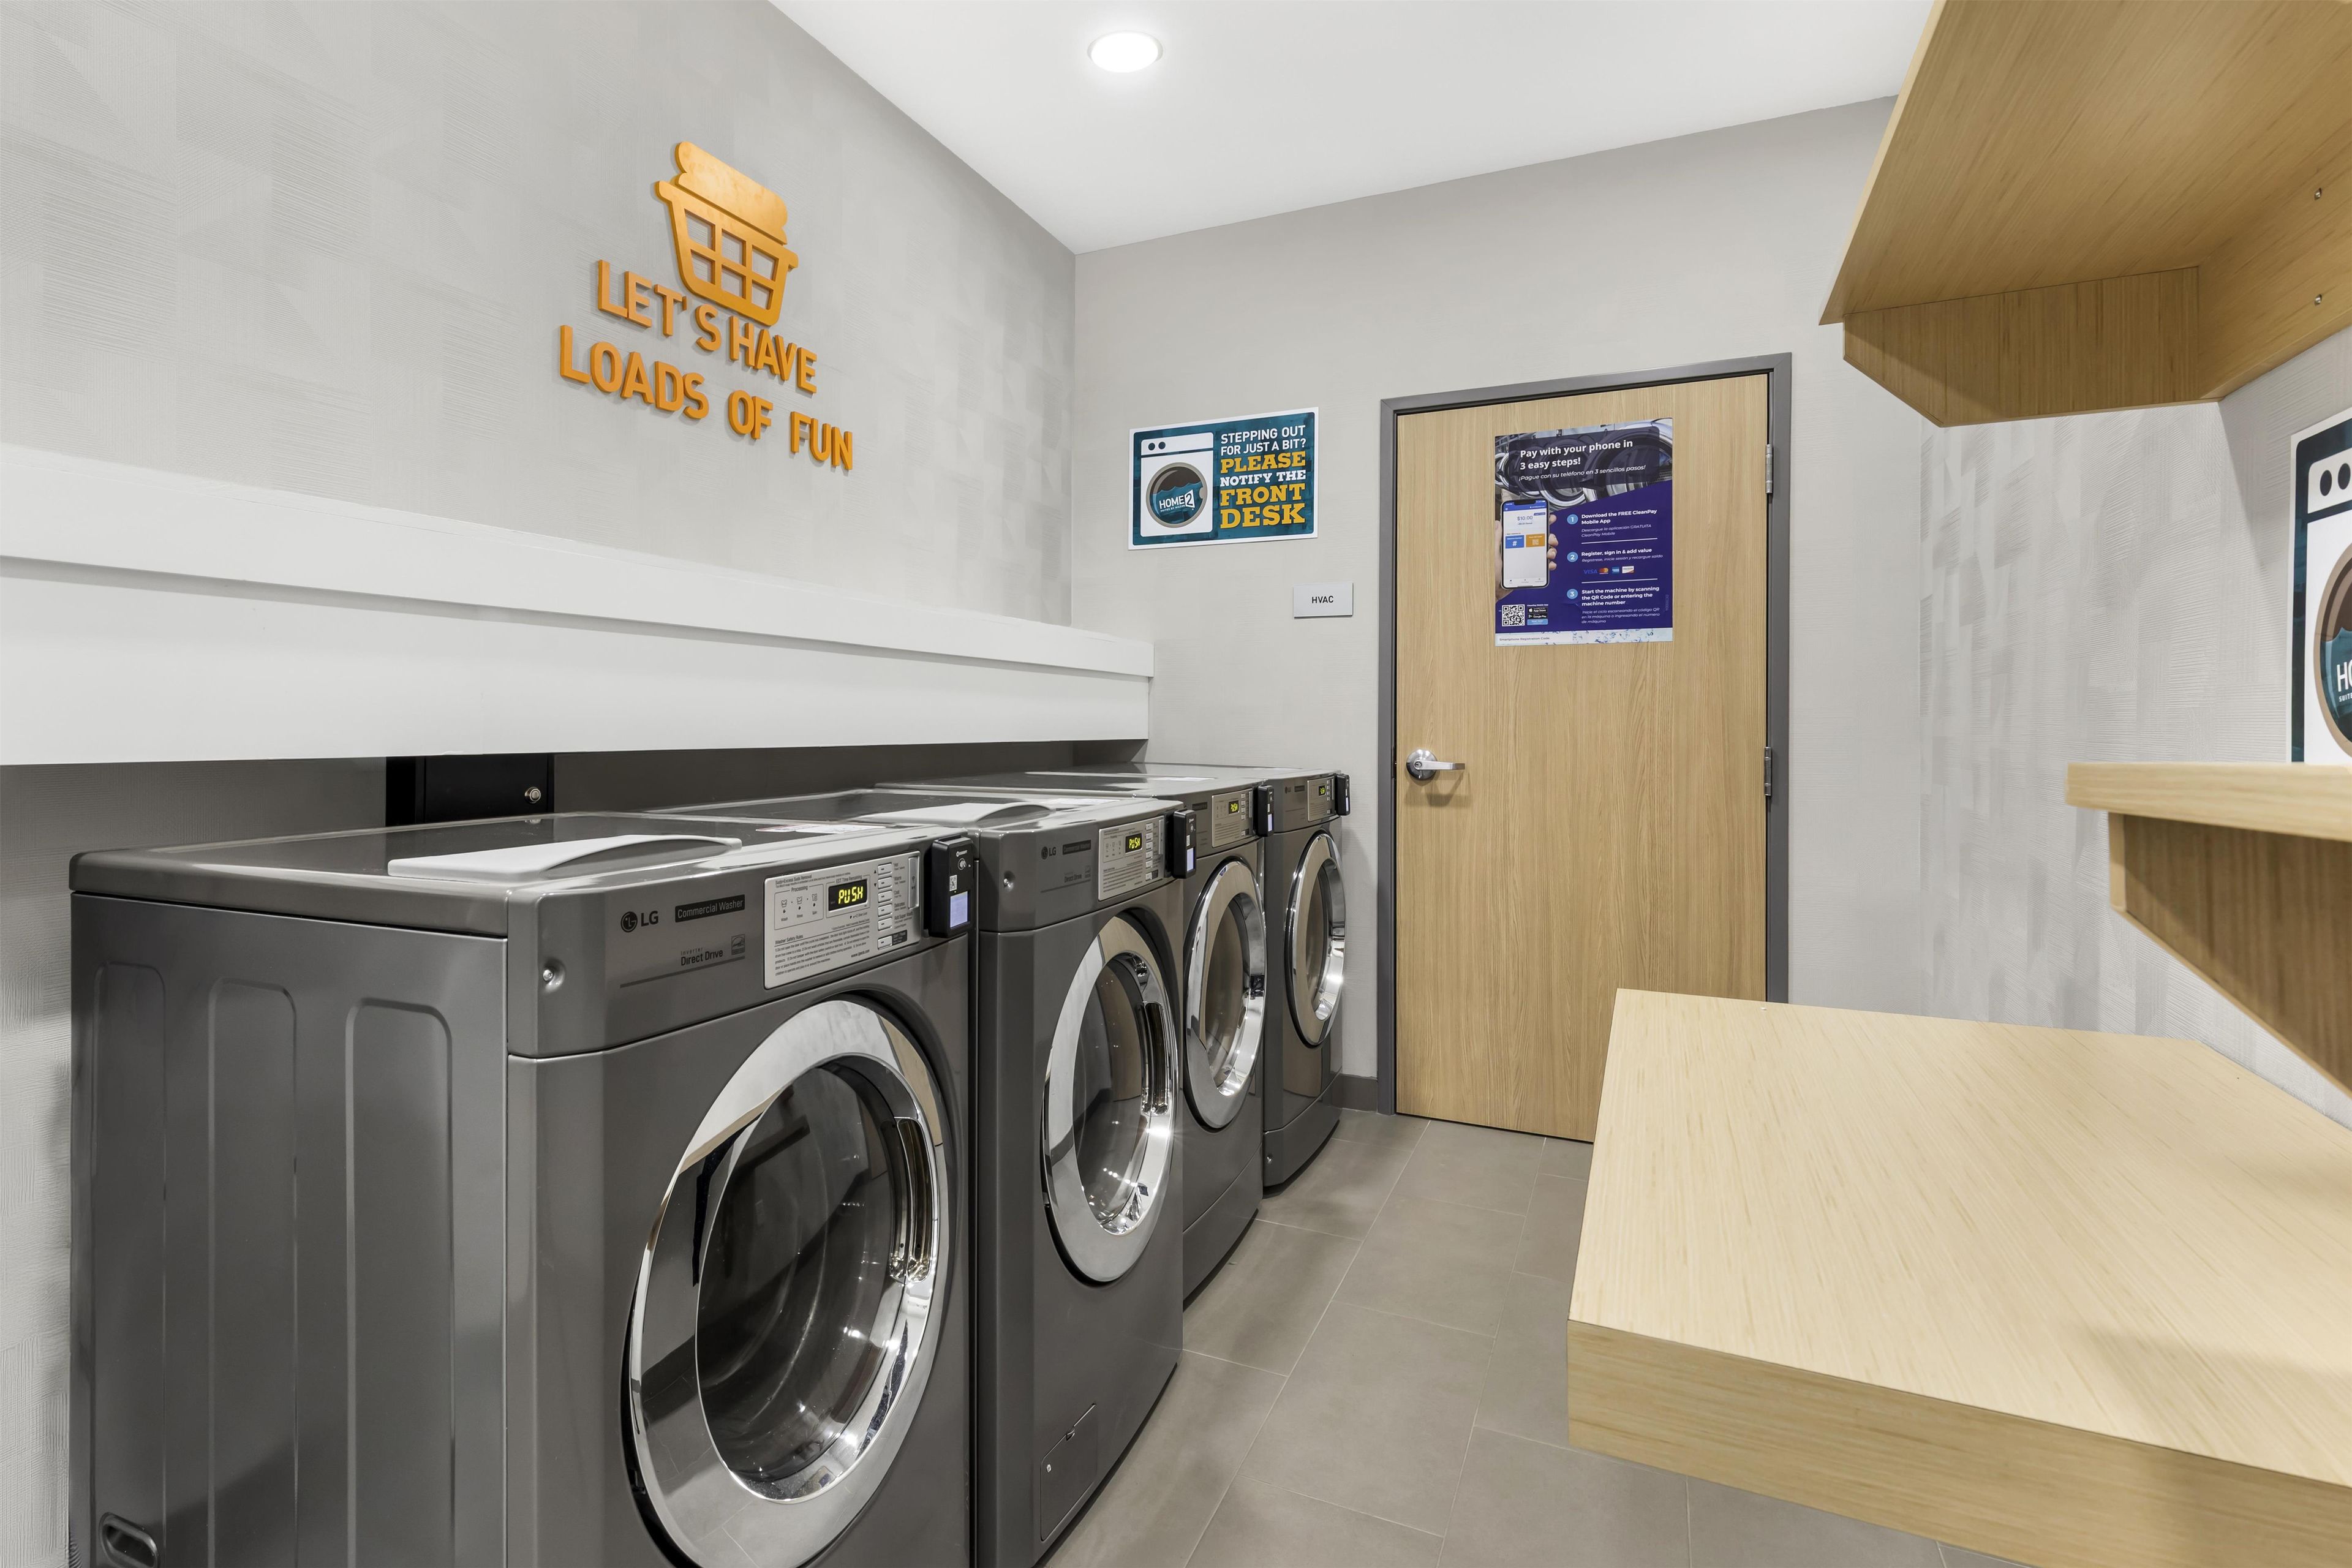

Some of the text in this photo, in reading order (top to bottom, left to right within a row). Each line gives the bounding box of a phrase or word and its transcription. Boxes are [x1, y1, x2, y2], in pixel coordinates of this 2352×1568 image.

[598, 260, 817, 393] LET'S HAVE
[560, 325, 853, 470] LOADS OF FUN
[1221, 425, 1306, 444] STEPPING OUT
[1221, 438, 1306, 456] FOR JUST A BIT?
[1520, 450, 1537, 459] Pay
[1539, 446, 1561, 456] with
[1563, 445, 1587, 456] your
[1589, 441, 1621, 453] phone
[1220, 451, 1306, 473] PLEASE
[1520, 457, 1581, 470] 3 easy steps!
[1220, 469, 1306, 487] NOTIFY THE
[1220, 483, 1305, 507] FRONT
[1220, 502, 1305, 529] DESK
[1049, 846, 1057, 857] LG
[1129, 837, 1140, 849] PUSH
[838, 886, 864, 905] PUSH
[641, 899, 744, 927] LG Commercial Washer
[681, 952, 703, 966] Direct
[704, 949, 723, 961] Drive
